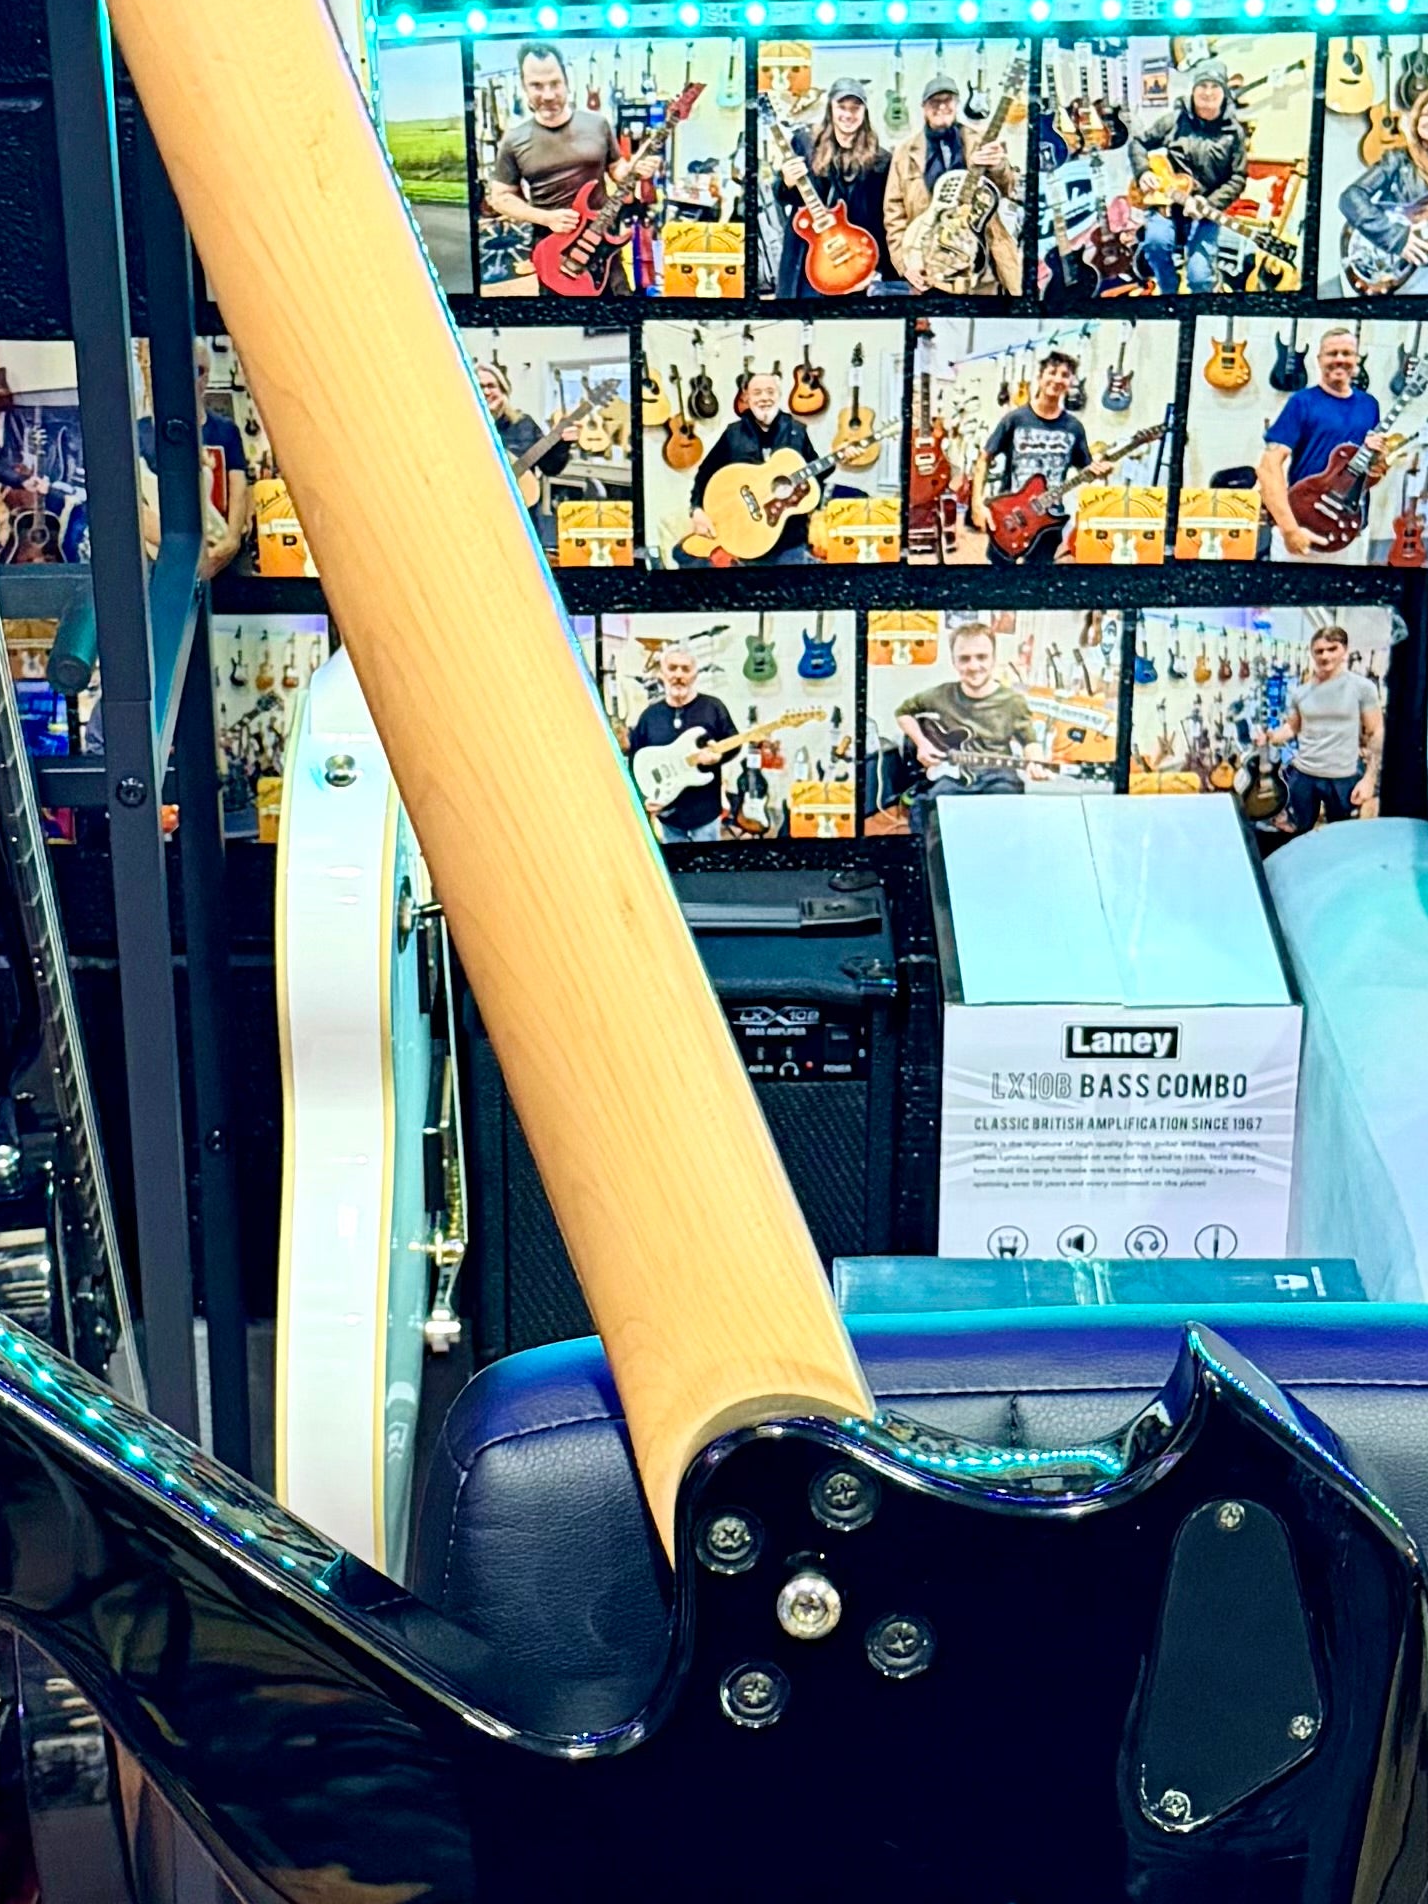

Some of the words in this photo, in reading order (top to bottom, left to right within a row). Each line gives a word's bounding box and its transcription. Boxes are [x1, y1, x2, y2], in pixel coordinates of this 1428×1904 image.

[1071, 1027, 1172, 1057] Laney
[991, 1072, 1071, 1100] LX10B
[1080, 1073, 1149, 1098] BASS
[1157, 1073, 1247, 1098] COMBO
[974, 1117, 1029, 1130] CLASSIC
[1032, 1117, 1084, 1130] BRITISH
[1087, 1117, 1188, 1130] AMPLIFICATION
[1192, 1117, 1228, 1130] SINCE
[1233, 1117, 1262, 1130] 1967
